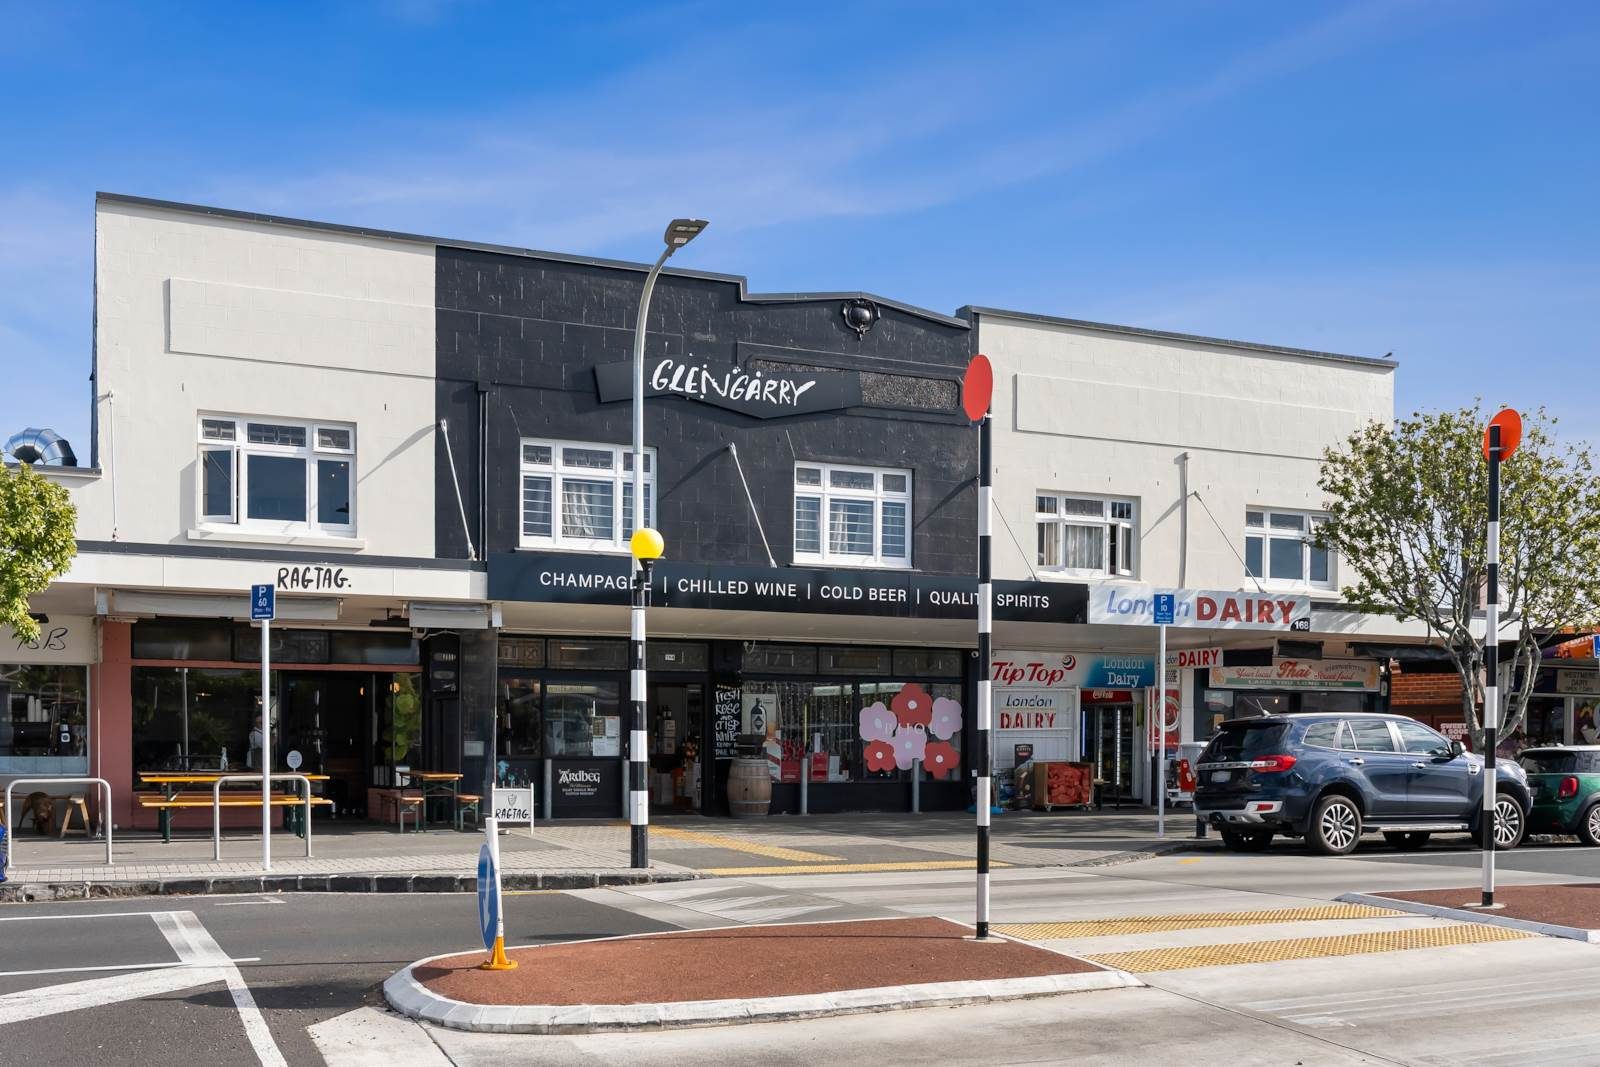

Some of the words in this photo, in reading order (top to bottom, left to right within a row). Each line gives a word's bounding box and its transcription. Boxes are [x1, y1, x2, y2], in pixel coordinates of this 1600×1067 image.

[649, 358, 816, 407] GLENGARRY
[258, 586, 267, 597] P
[540, 571, 652, 591] CHAMPAGE
[677, 578, 749, 595] CHILLED
[755, 582, 797, 597] WINE
[820, 585, 864, 600] COLD
[868, 587, 907, 602] BEER
[929, 590, 980, 605] QUALIT
[996, 593, 1050, 609] SPIRITS
[258, 597, 268, 607] 60
[1160, 595, 1168, 604] P
[1196, 597, 1298, 625] DAIRY
[1294, 619, 1309, 631] 168
[1103, 655, 1146, 670] London
[1179, 648, 1220, 668] DAIRY
[991, 660, 1025, 686] Tip
[1026, 662, 1065, 686] Top
[1277, 659, 1313, 679] Thai
[1107, 671, 1141, 688] Dairy
[1006, 694, 1053, 708] London
[1000, 711, 1057, 730] DAIRY
